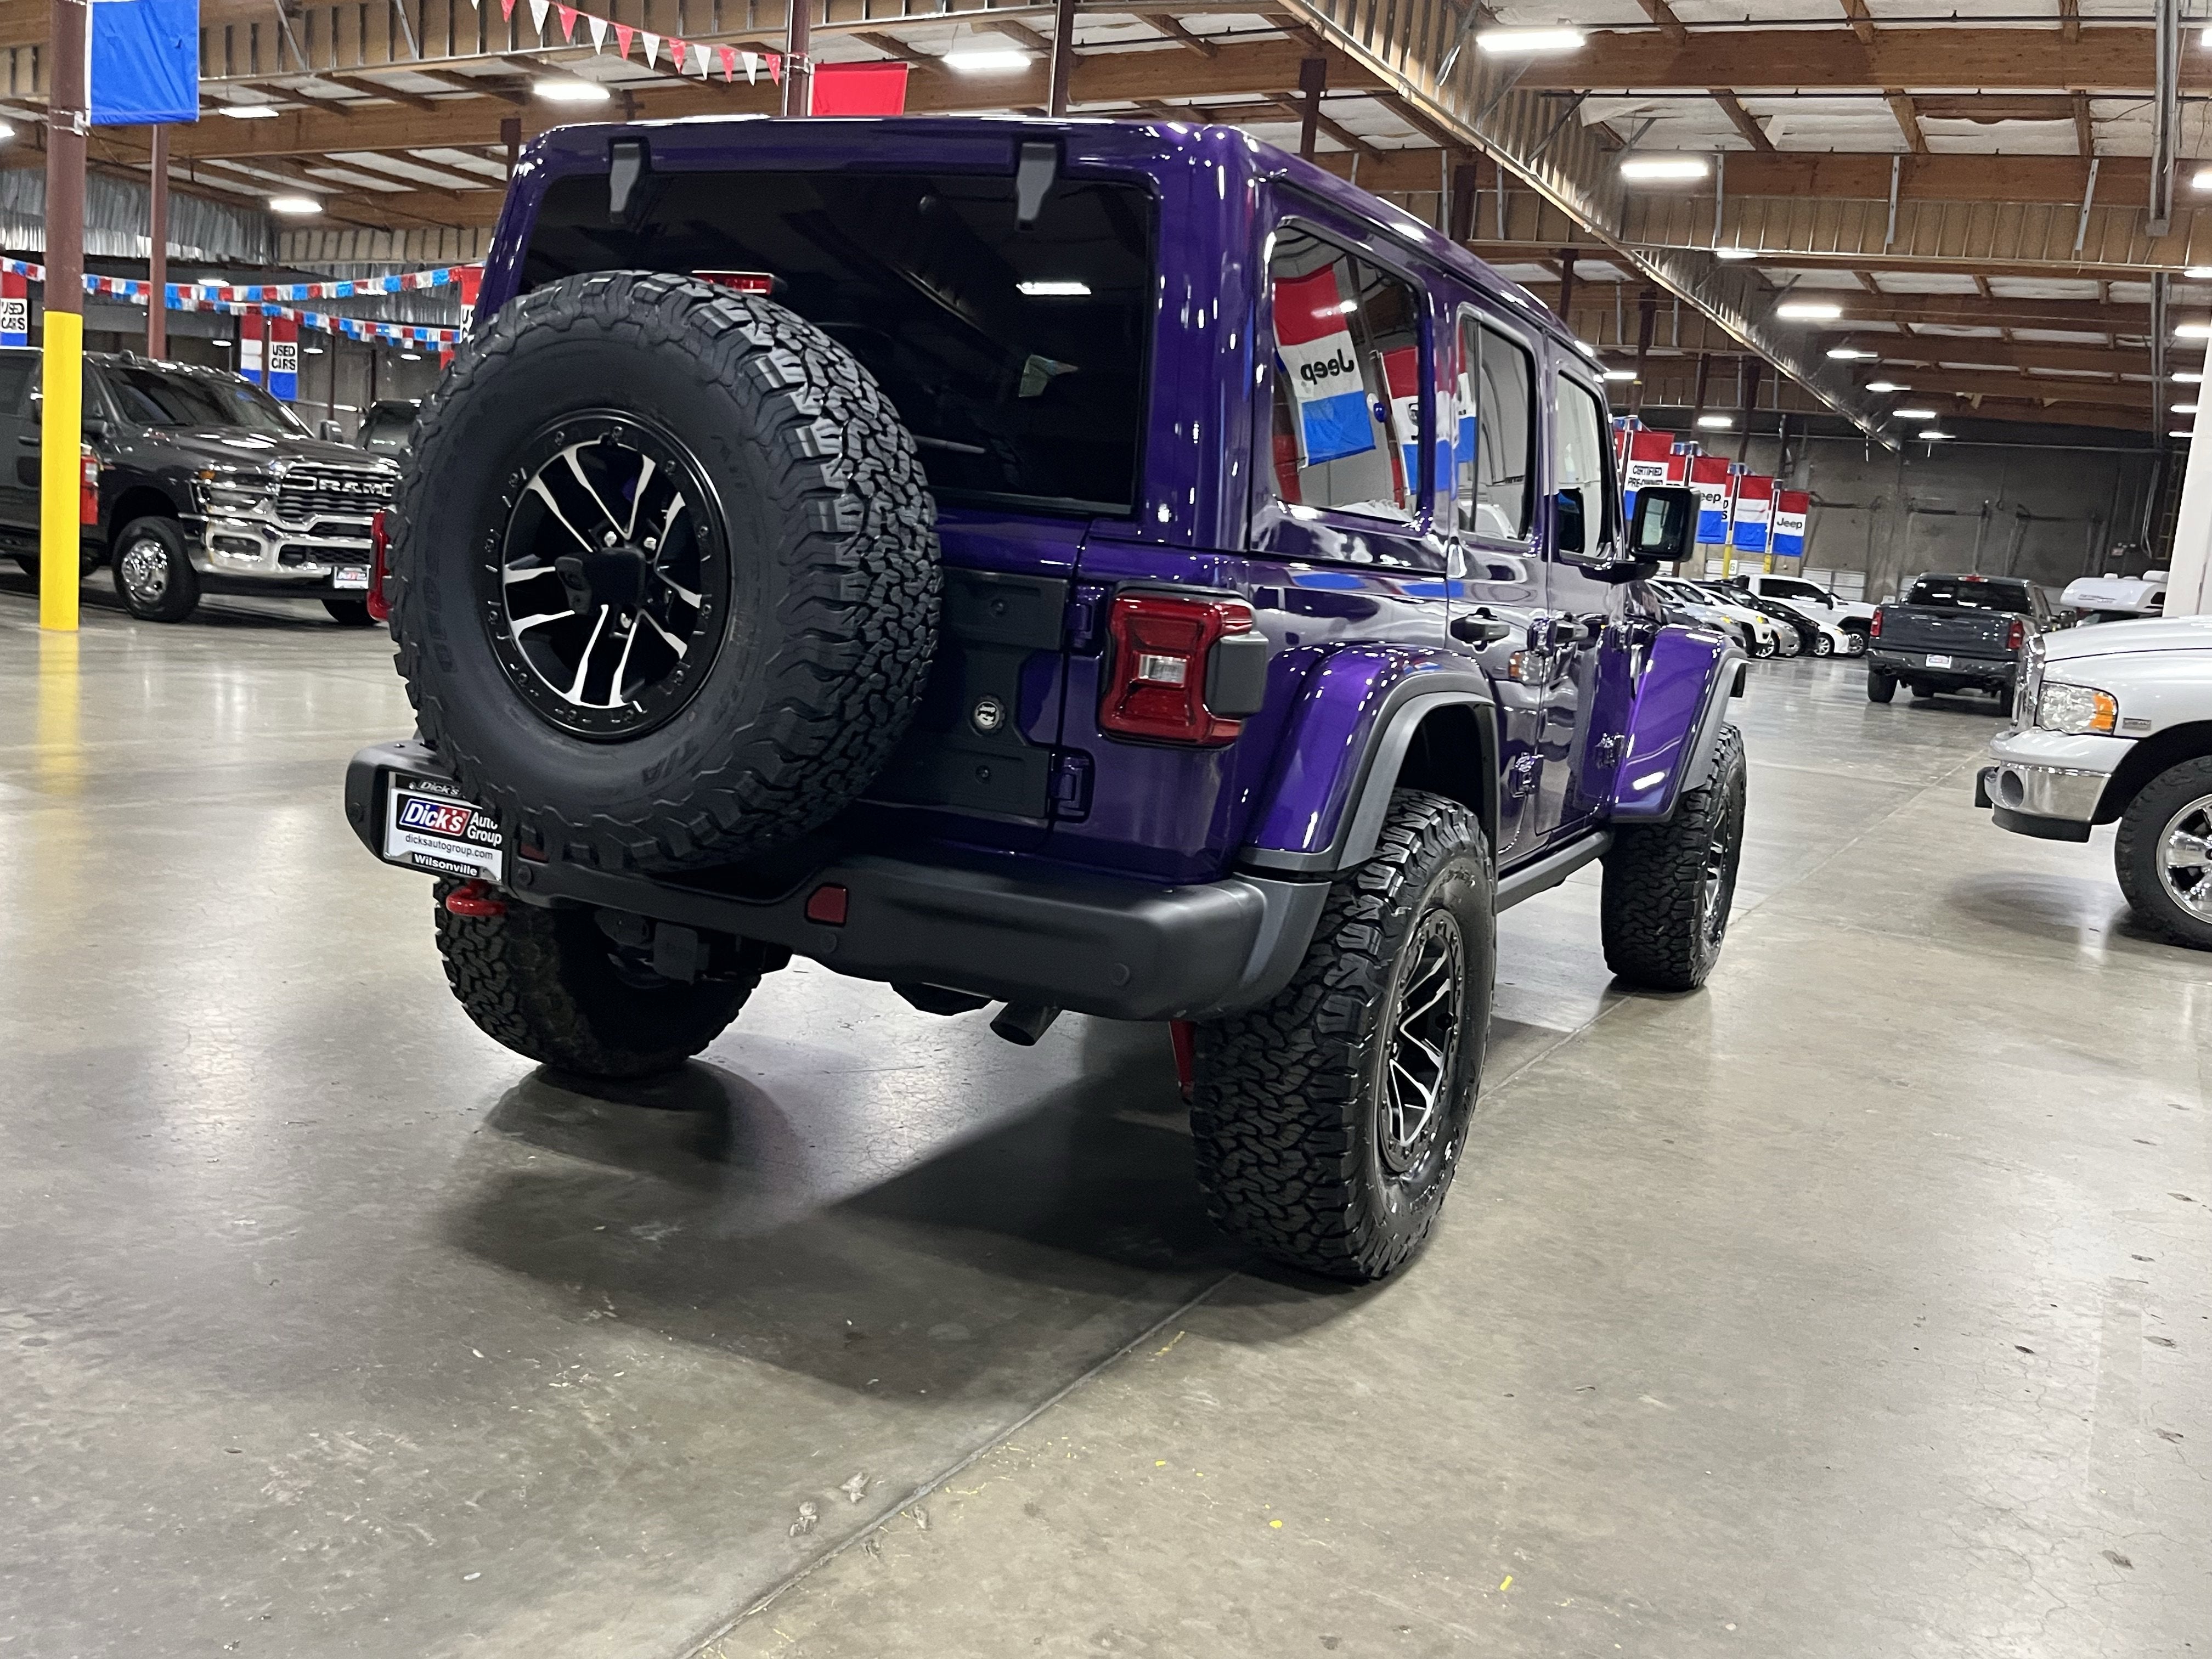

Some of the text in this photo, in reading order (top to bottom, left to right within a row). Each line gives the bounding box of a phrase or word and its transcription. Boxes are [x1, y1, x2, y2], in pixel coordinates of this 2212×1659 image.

[273, 345, 295, 357] USED
[272, 358, 296, 370] CARS
[319, 479, 383, 494] RAM
[1700, 493, 1722, 504] eep
[1776, 518, 1803, 531] Jeep
[420, 781, 460, 795] Dick's
[404, 803, 464, 833] Dick's
[467, 825, 503, 847] Group
[405, 833, 494, 860] dicksautogroup.com
[414, 854, 478, 876] Wilsonville
